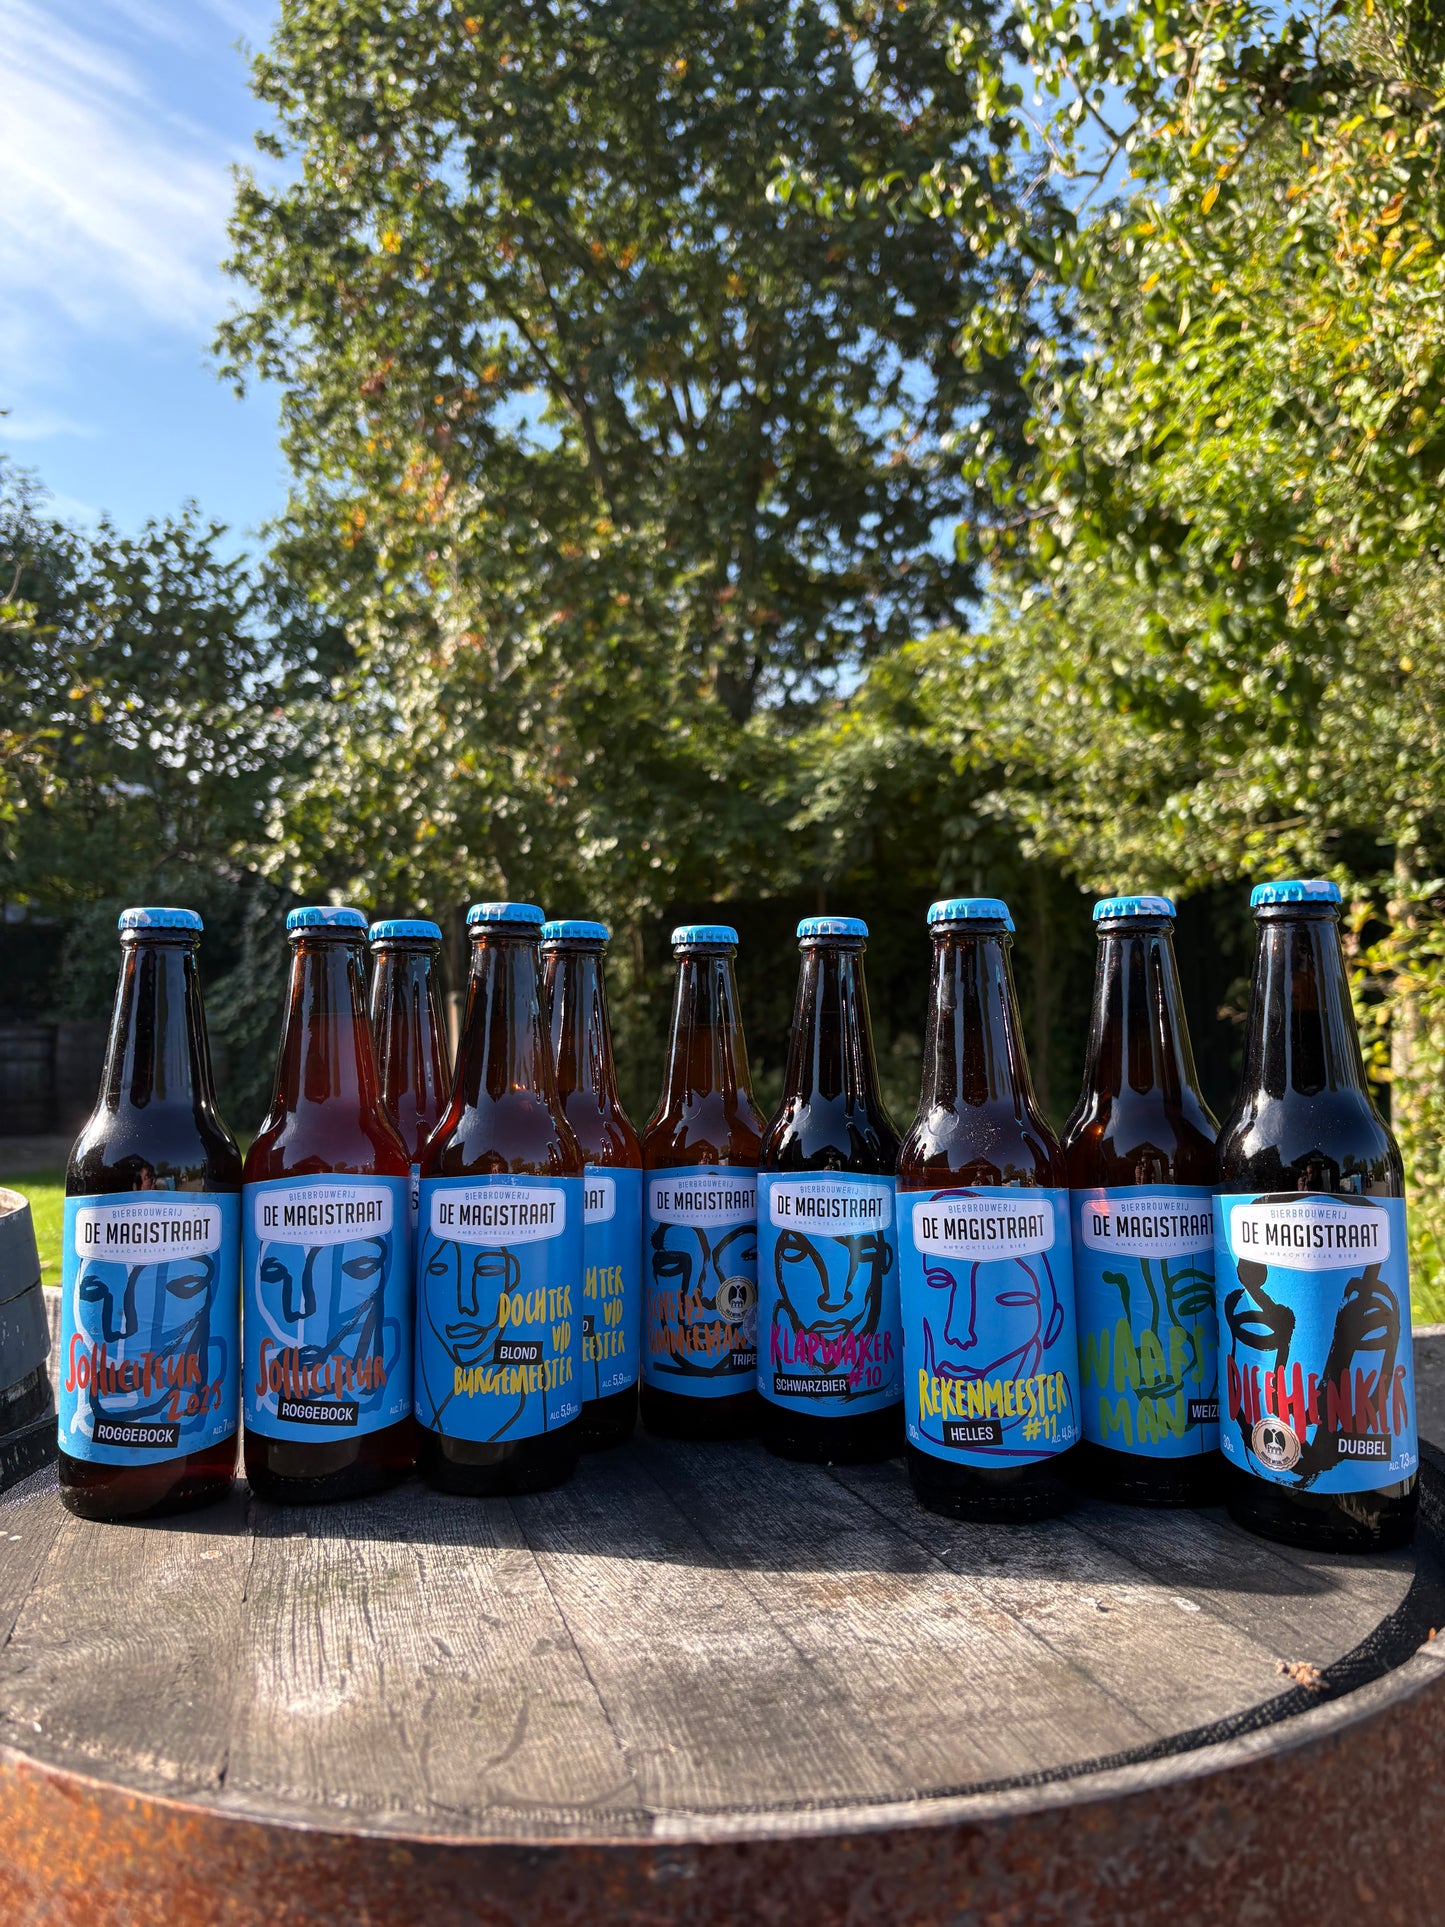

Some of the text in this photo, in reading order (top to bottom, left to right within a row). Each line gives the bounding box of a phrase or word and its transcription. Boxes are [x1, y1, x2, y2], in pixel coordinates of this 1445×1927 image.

[678, 1180, 733, 1190] BIERBROUWERIJ
[800, 1185, 859, 1195] BIERBROUWERIJ
[289, 1190, 356, 1201] BIERBROUWERIJ
[465, 1191, 530, 1201] BIERBROUWERIJ
[657, 1191, 670, 1210] DE
[112, 1208, 182, 1219] BIERBROUWERIJ
[263, 1205, 279, 1227] DE
[284, 1200, 383, 1227] MAGISTRAAT
[439, 1202, 556, 1226] DE MAGISTRAAT
[777, 1195, 883, 1218] DE MAGISTRAAT
[948, 1203, 1017, 1214] BIERBROUWERIJ
[1121, 1202, 1189, 1212] BIERBROUWERIJ
[1270, 1209, 1347, 1220] BIERBROUWERIJ
[85, 1218, 211, 1244] DE MAGISTRAAT
[922, 1214, 1045, 1240] DE MAGISTRAAT
[1093, 1215, 1111, 1237] DE
[1242, 1220, 1379, 1248] DE MAGISTRAAT
[583, 1265, 625, 1300] HTER
[498, 1284, 573, 1328] DOCHTER
[500, 1346, 538, 1360] BLOND
[770, 1321, 895, 1369] KLAPWAKER
[732, 1353, 757, 1366] TRIPE
[453, 1356, 573, 1398] BURGEMEESTER
[775, 1378, 847, 1393] SCHWARZBIER
[846, 1366, 882, 1388] #10
[167, 1380, 224, 1422] 2025
[918, 1368, 1067, 1422] REKENMEESTER
[282, 1402, 354, 1421] ROGGEBOCK
[1099, 1390, 1186, 1447] MAN
[1191, 1404, 1219, 1418] WEIZ
[97, 1424, 175, 1443] ROGGEBOCK
[950, 1426, 994, 1441] HELLES
[1022, 1414, 1057, 1442] #11
[1338, 1438, 1387, 1456] DUBBEL
